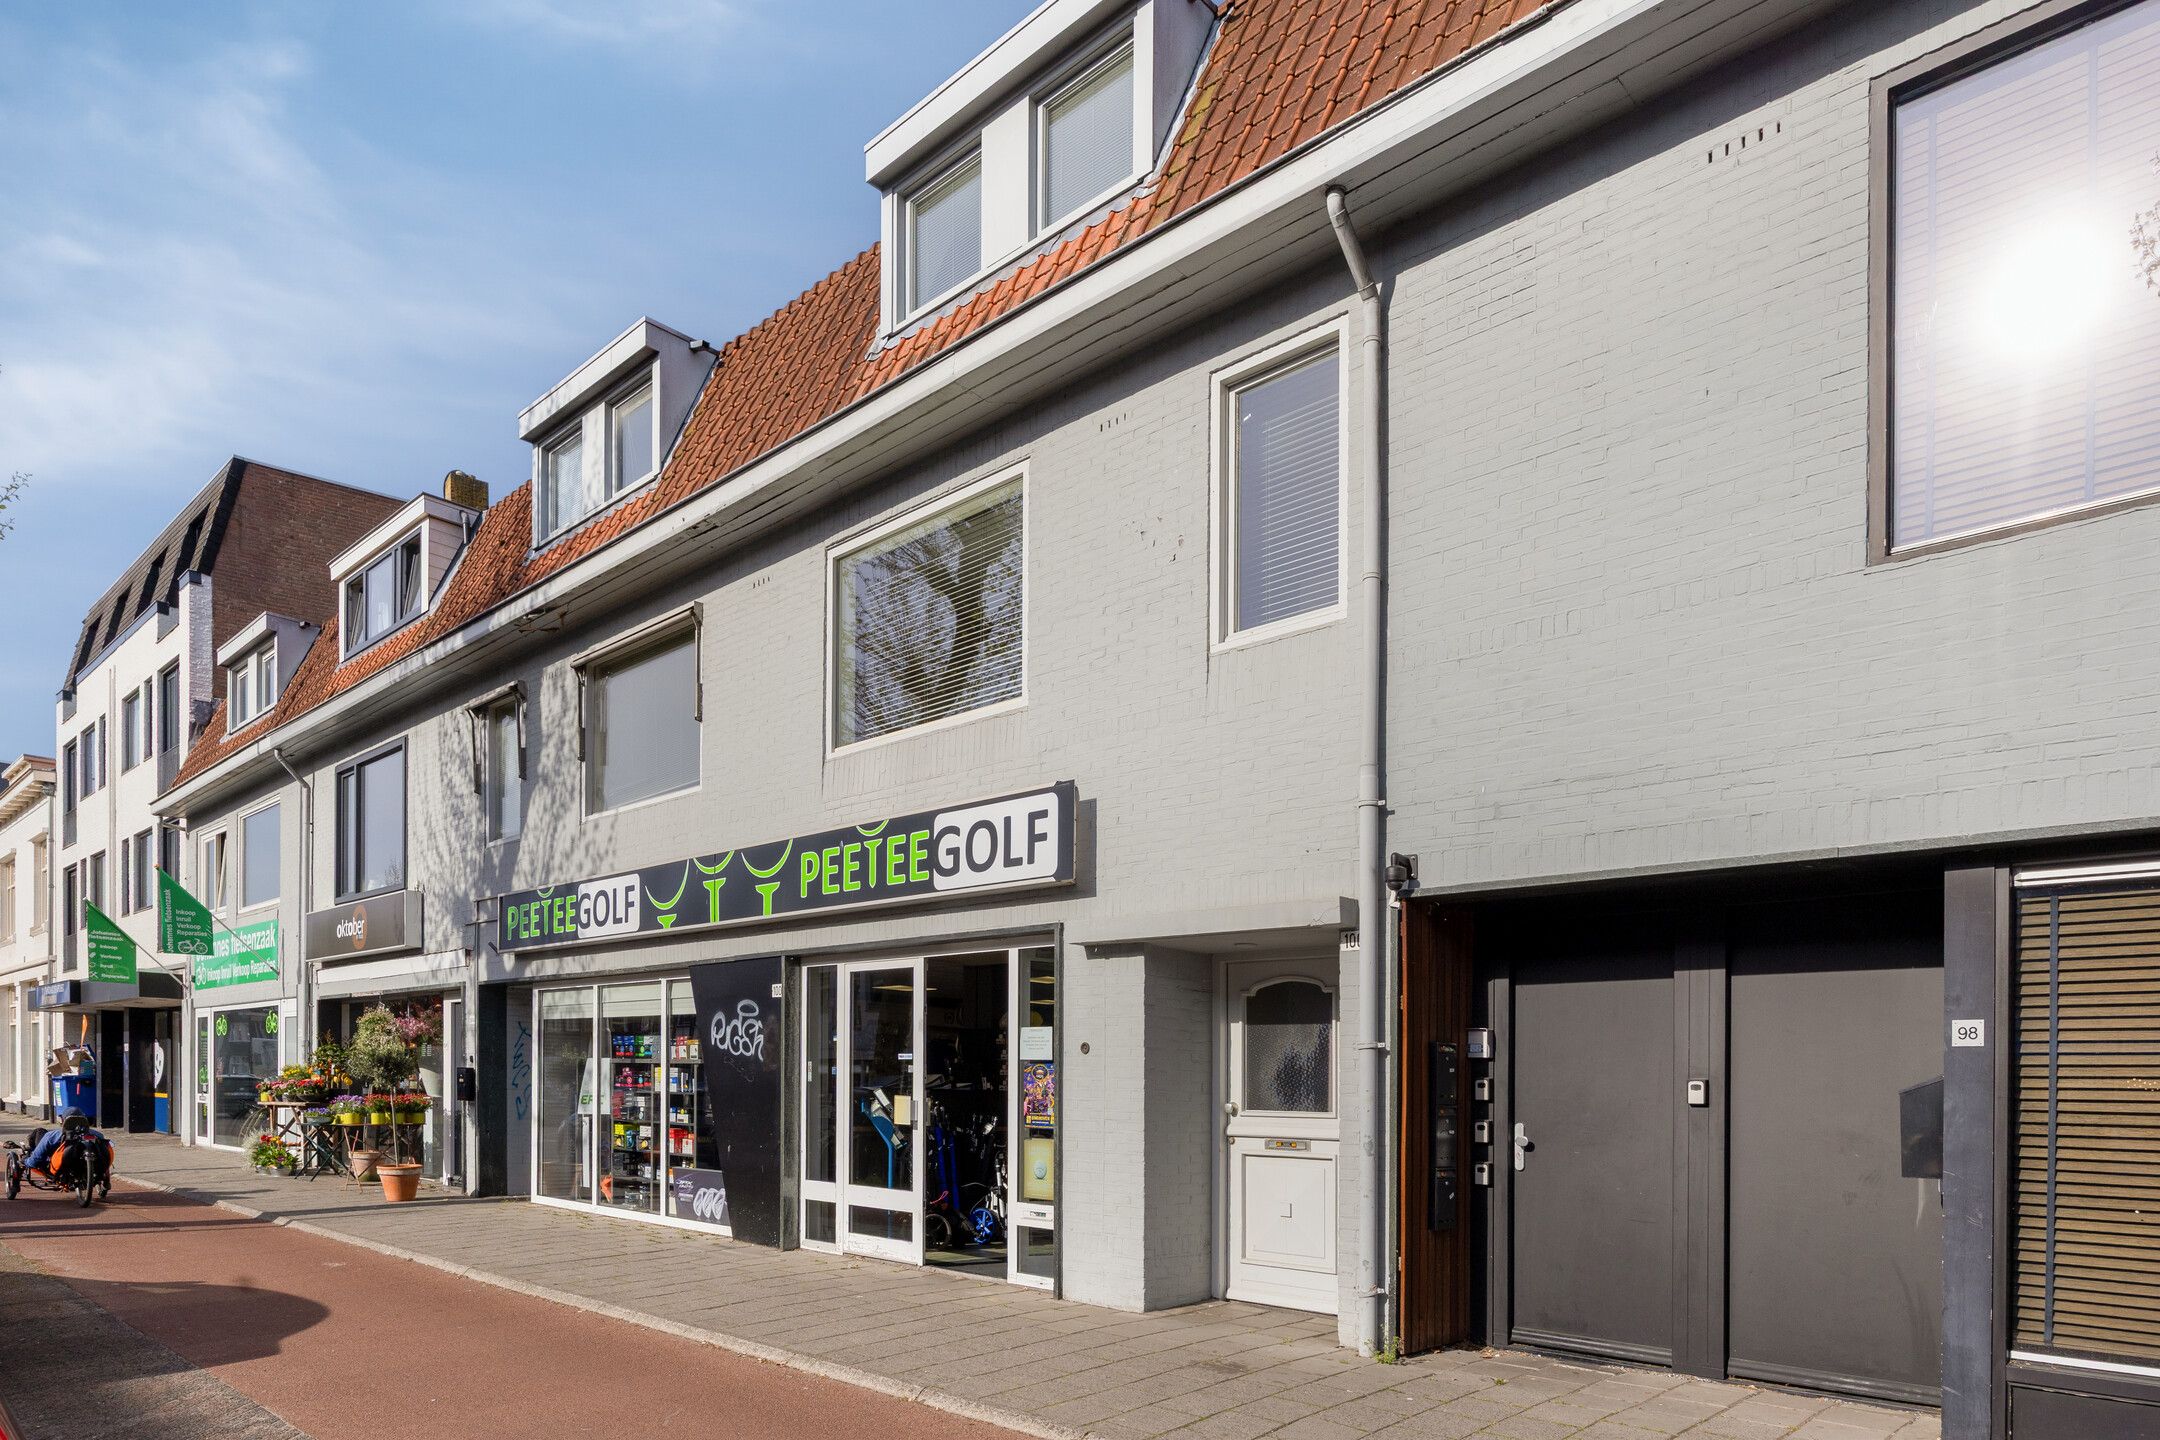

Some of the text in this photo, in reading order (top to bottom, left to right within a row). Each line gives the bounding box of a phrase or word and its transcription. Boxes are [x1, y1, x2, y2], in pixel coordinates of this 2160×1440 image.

[800, 808, 1049, 898] PEETEE GOLF
[175, 909, 196, 917] Inkoop
[579, 884, 636, 930] GOLF
[336, 916, 365, 939] oktober
[1957, 1026, 1978, 1040] 98
